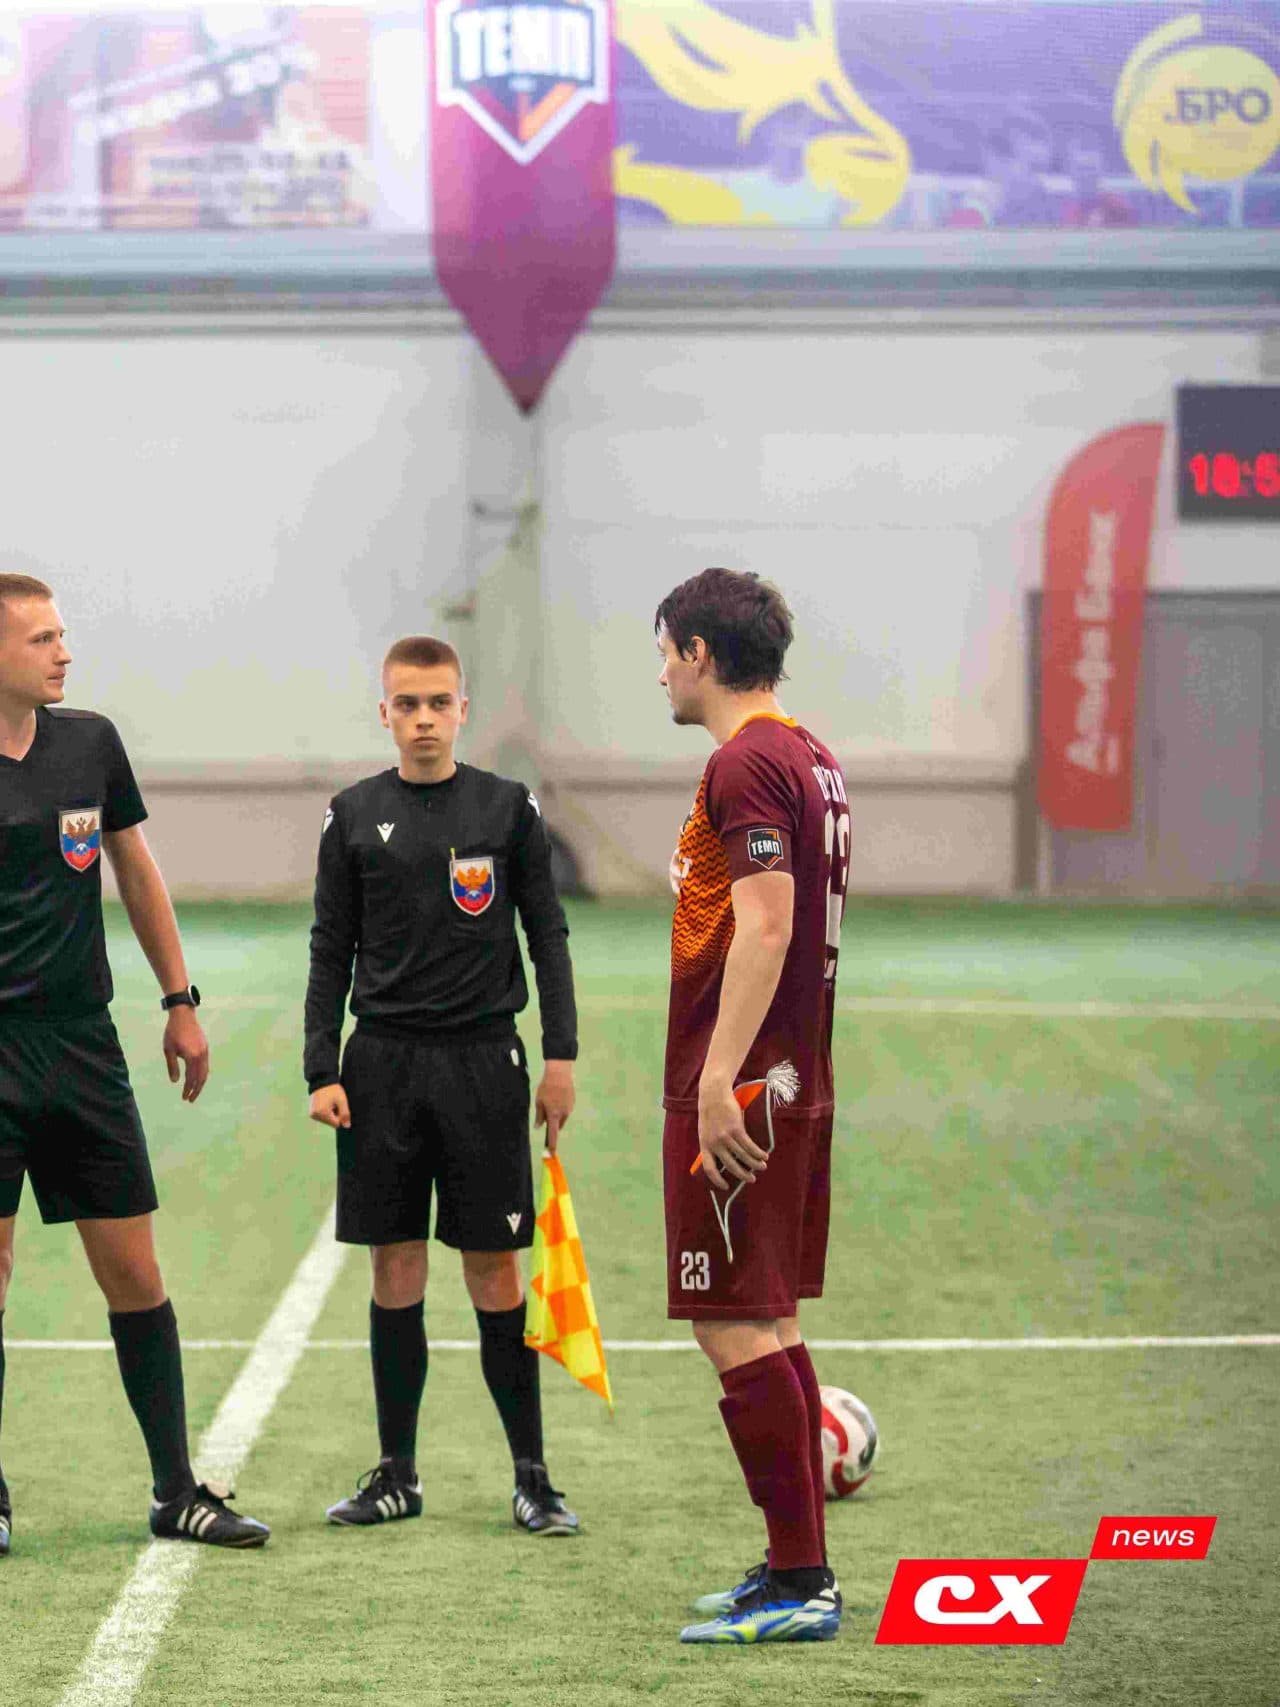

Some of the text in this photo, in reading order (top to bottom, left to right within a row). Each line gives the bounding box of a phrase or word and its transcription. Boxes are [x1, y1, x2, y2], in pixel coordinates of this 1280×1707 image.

[453, 7, 593, 82] ТЕМП
[750, 839, 781, 856] ТЕМП
[680, 1250, 711, 1291] 23
